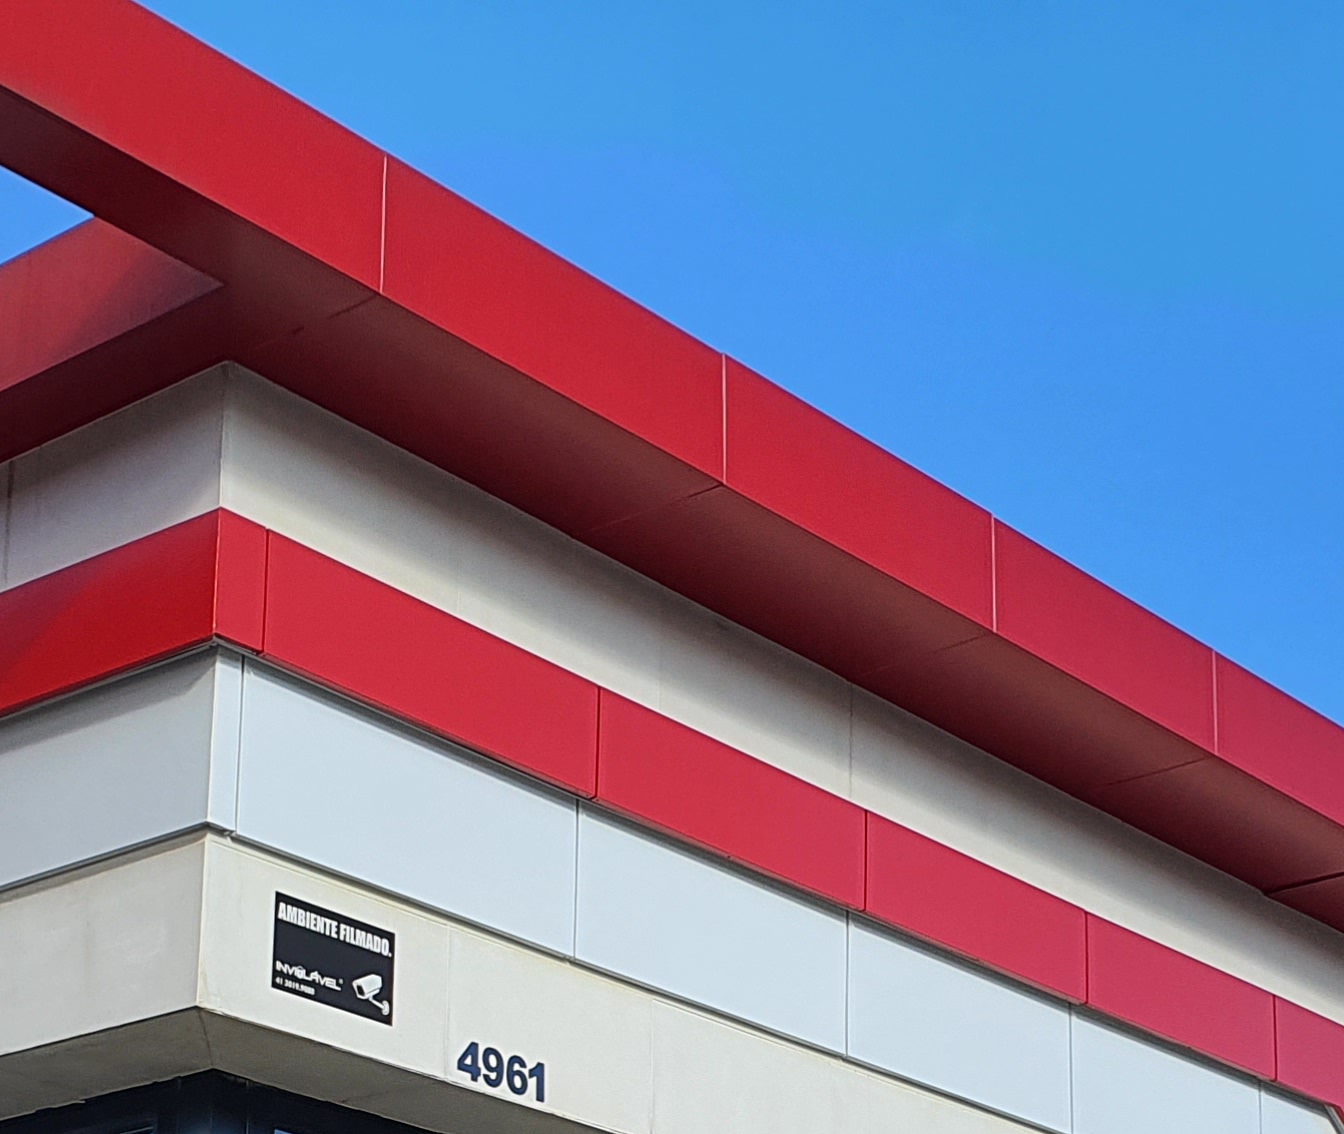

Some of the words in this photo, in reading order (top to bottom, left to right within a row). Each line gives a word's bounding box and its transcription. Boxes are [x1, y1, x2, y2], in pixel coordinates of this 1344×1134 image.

[278, 901, 339, 939] AMBIENTE
[339, 922, 392, 958] FILMADO.
[457, 1041, 545, 1103] 4961
